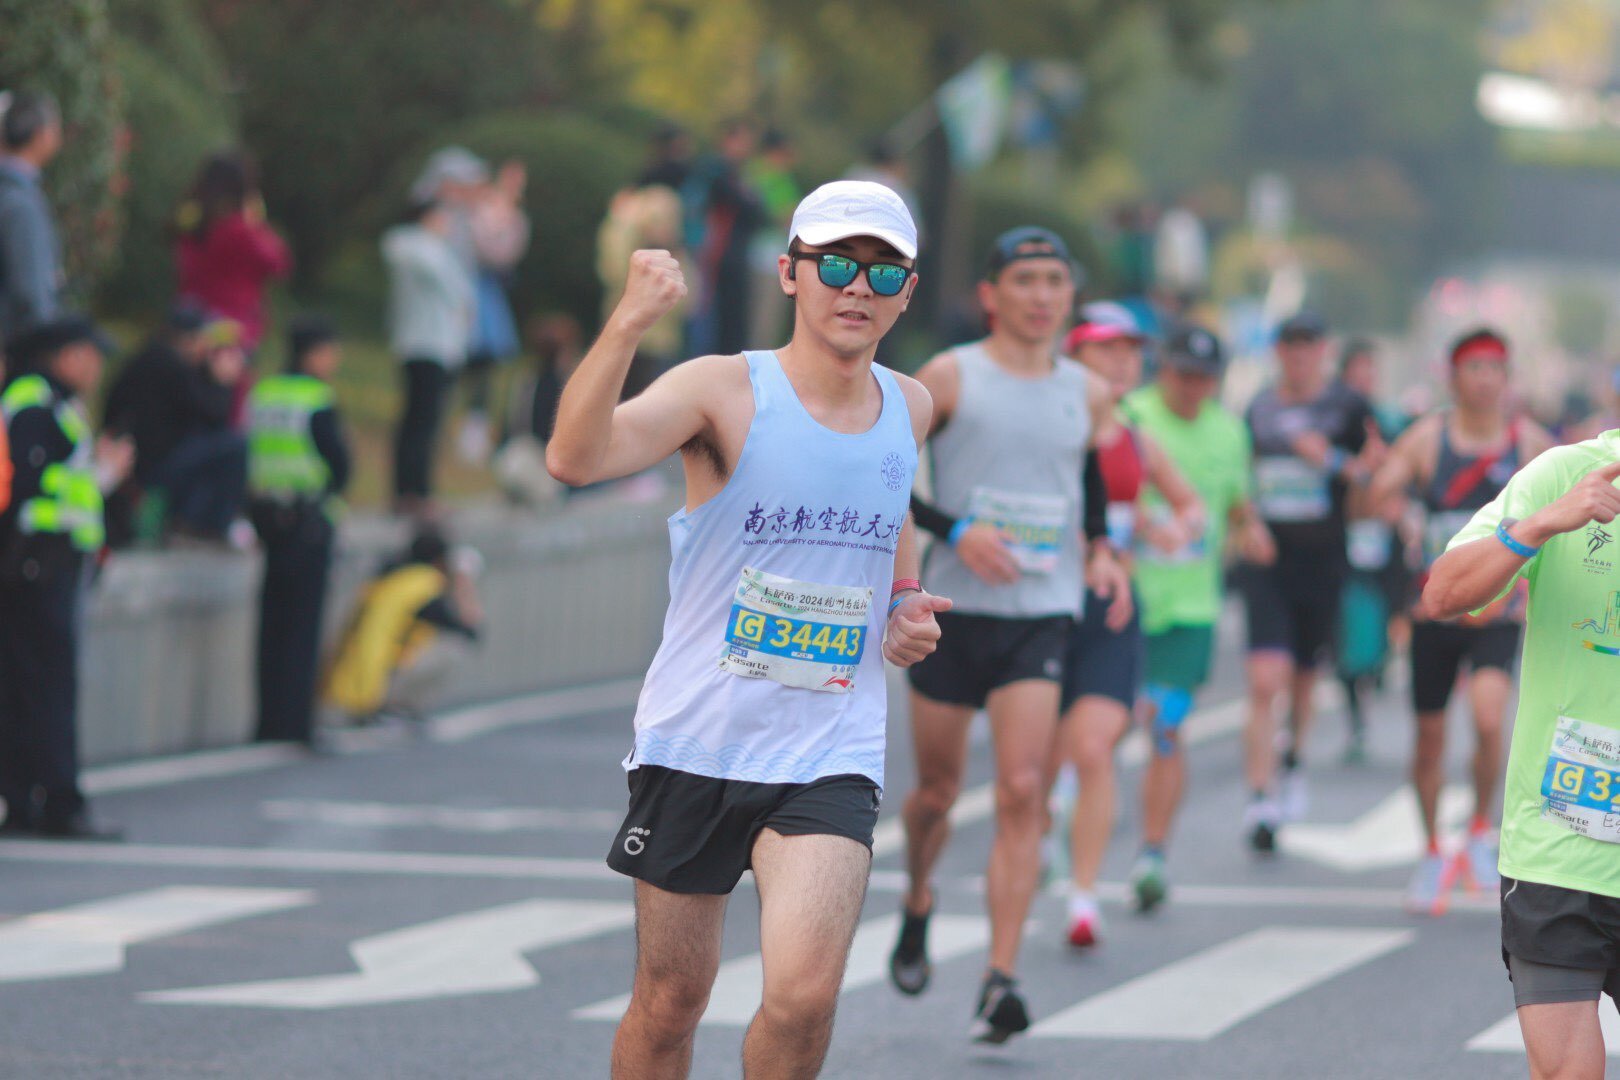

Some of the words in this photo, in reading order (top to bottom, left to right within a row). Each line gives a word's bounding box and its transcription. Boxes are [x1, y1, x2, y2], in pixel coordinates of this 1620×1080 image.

[760, 597, 792, 609] Casarte
[740, 612, 760, 638] G
[769, 619, 861, 657] 34443
[727, 653, 769, 671] Casarte
[1558, 765, 1579, 791] G
